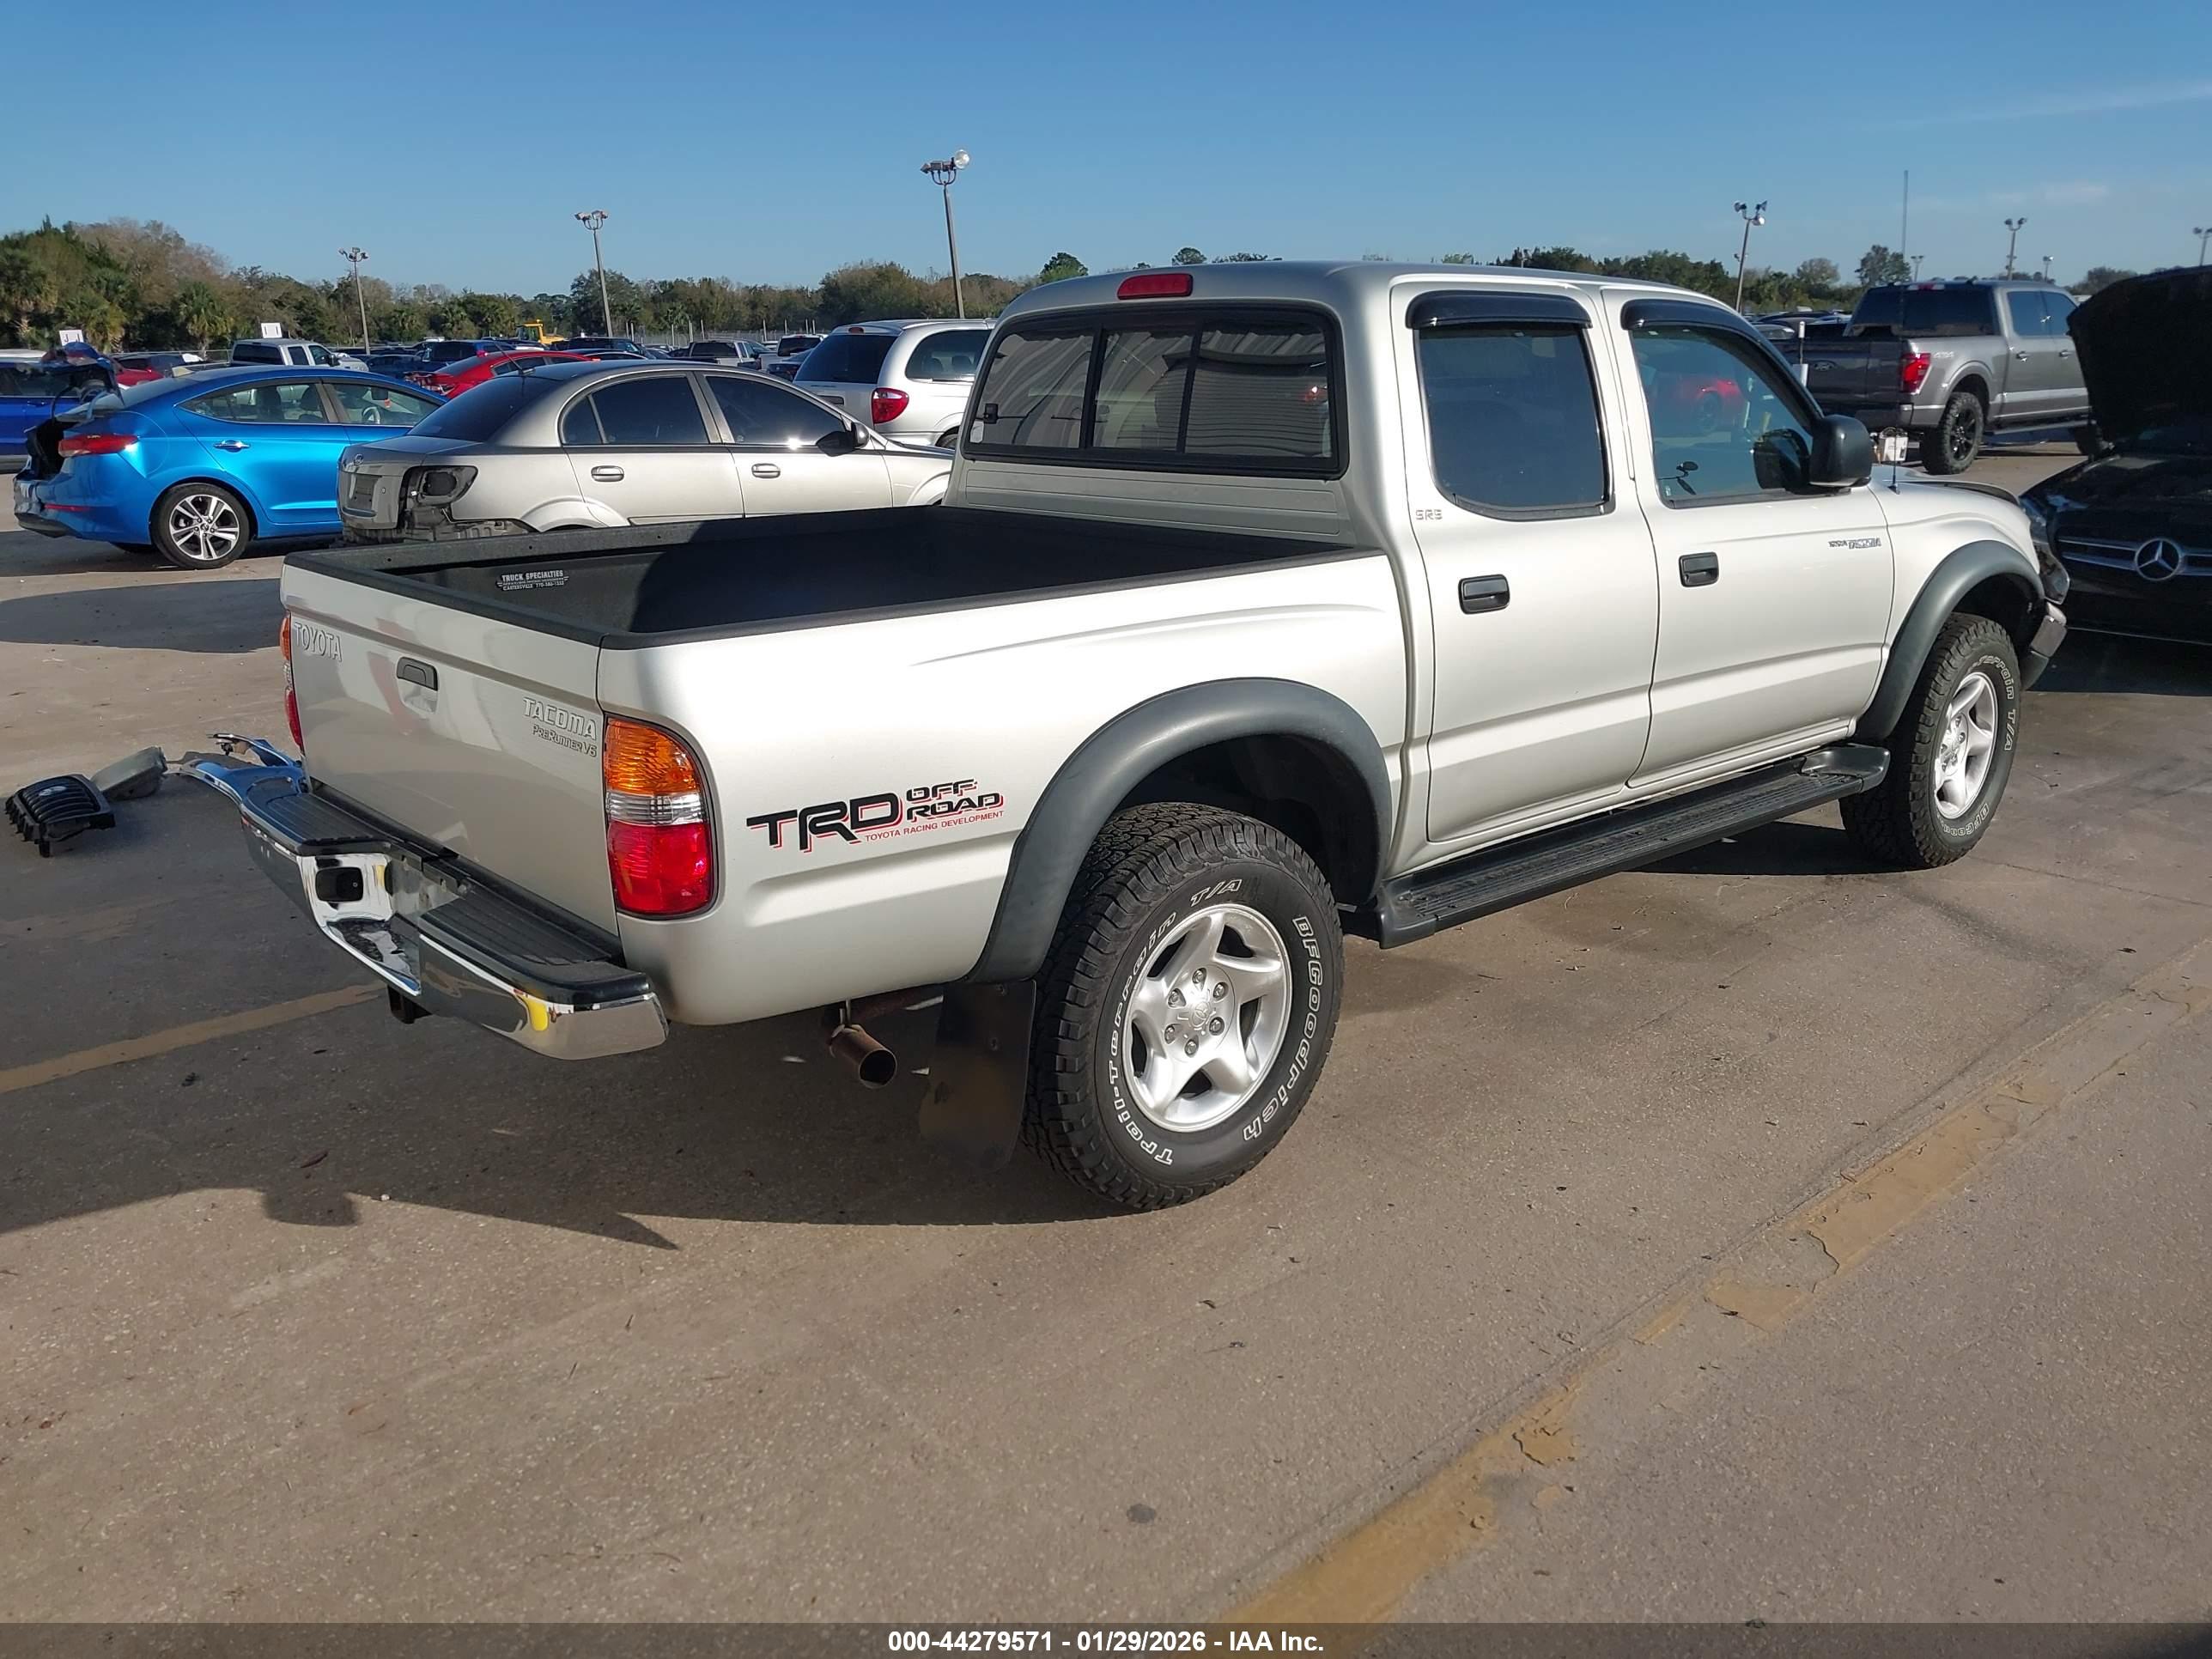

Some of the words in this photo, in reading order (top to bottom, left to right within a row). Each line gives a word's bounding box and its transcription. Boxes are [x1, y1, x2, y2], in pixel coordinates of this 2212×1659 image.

[1415, 508, 1443, 520] SRS
[501, 573, 524, 582] TRUCK
[526, 570, 564, 580] SPECIALTIES
[294, 621, 343, 662] TOYOTA
[523, 696, 597, 741] TACOMA
[2004, 708, 2016, 751] T/A
[906, 778, 977, 804] OFF
[746, 792, 903, 853] TRD
[906, 793, 1004, 823] ROAD
[865, 830, 901, 842] TOYOTA
[903, 823, 939, 836] RACING
[941, 810, 1005, 828] DEVELOPMENT
[1190, 878, 1242, 907] T/A
